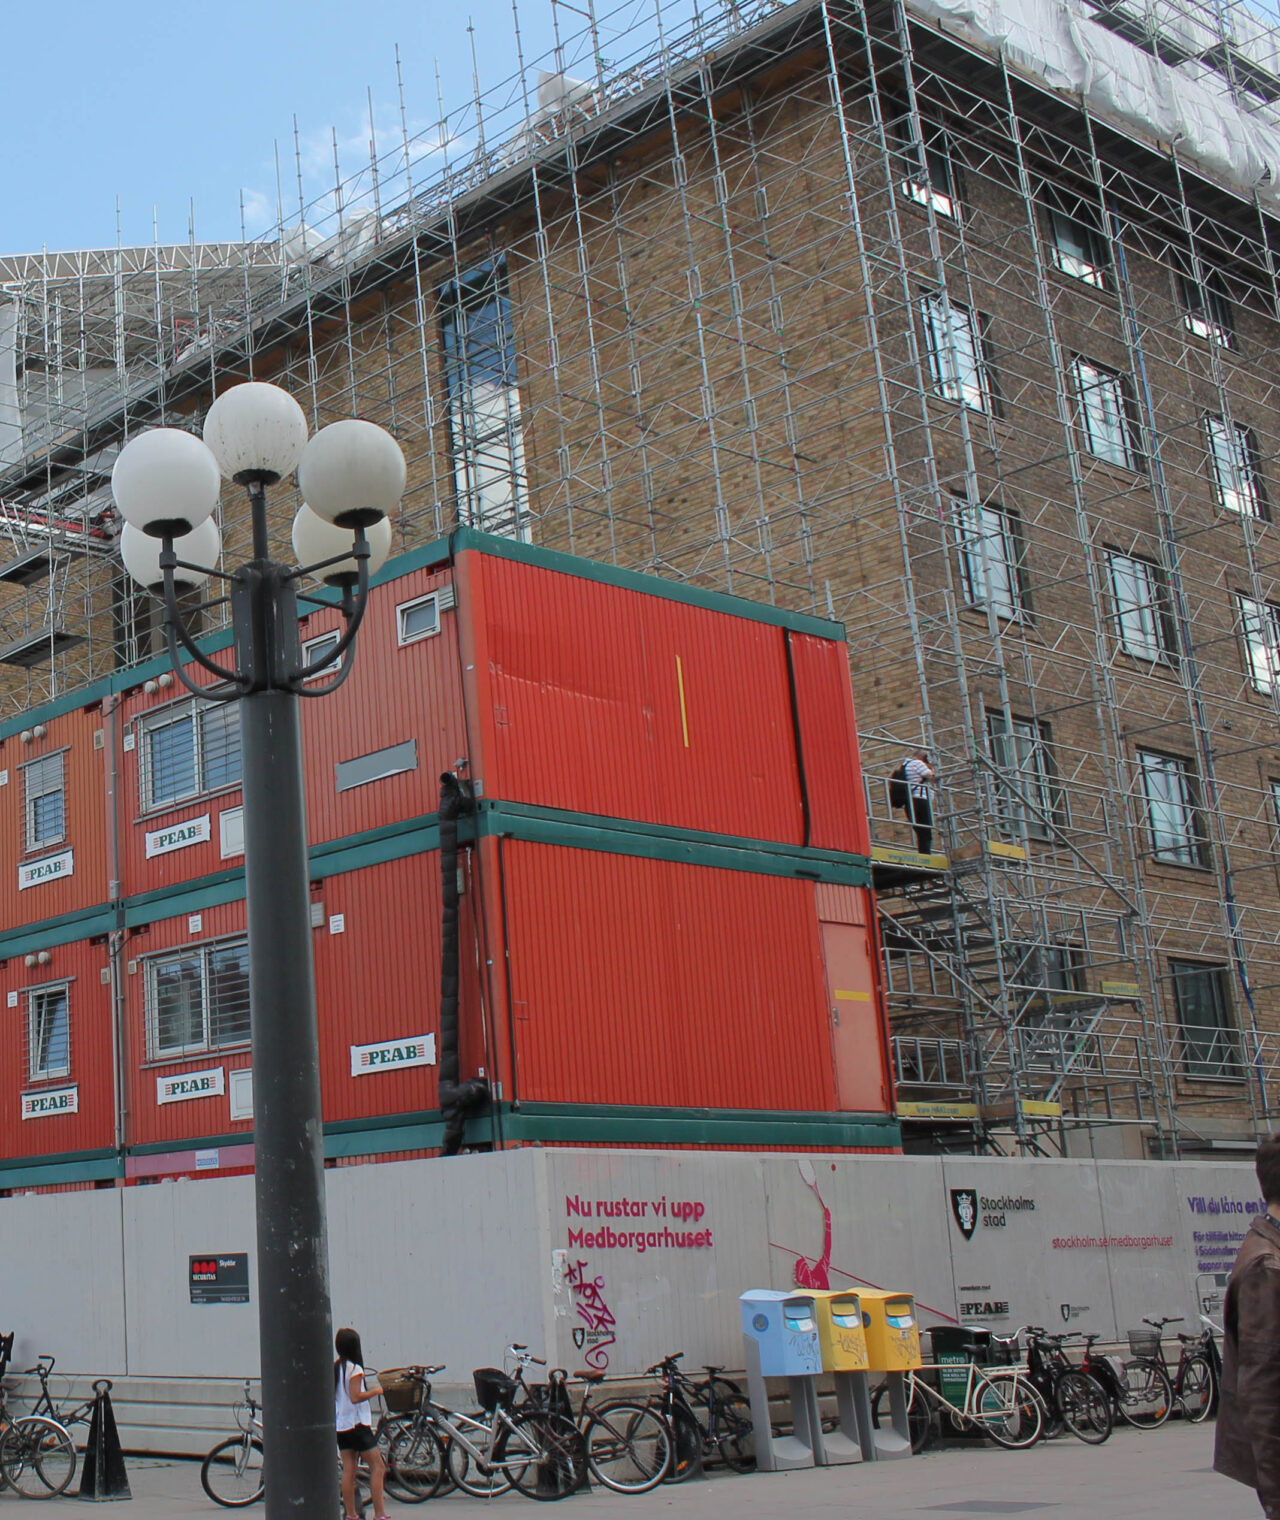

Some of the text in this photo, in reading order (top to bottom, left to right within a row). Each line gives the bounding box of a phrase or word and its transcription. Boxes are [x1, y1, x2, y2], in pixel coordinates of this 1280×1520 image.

[159, 826, 196, 847] PEAB
[30, 861, 61, 880] PEAB
[368, 1045, 417, 1065] PEAB
[170, 1077, 210, 1095] PEAB
[31, 1095, 68, 1112] PEAB
[566, 1195, 705, 1222] Nu rustar vi upp
[980, 1196, 1035, 1210] Stockholms
[1187, 1197, 1206, 1214] Vill
[1207, 1197, 1220, 1214] du
[1221, 1196, 1243, 1214] låna
[1245, 1201, 1259, 1214] en
[983, 1212, 1006, 1227] stad
[568, 1226, 713, 1253] Medborgarhuset
[1052, 1235, 1173, 1249] stockholm.se/medborgarhuset
[966, 1302, 1004, 1315] PEAB
[941, 1356, 965, 1364] metro
